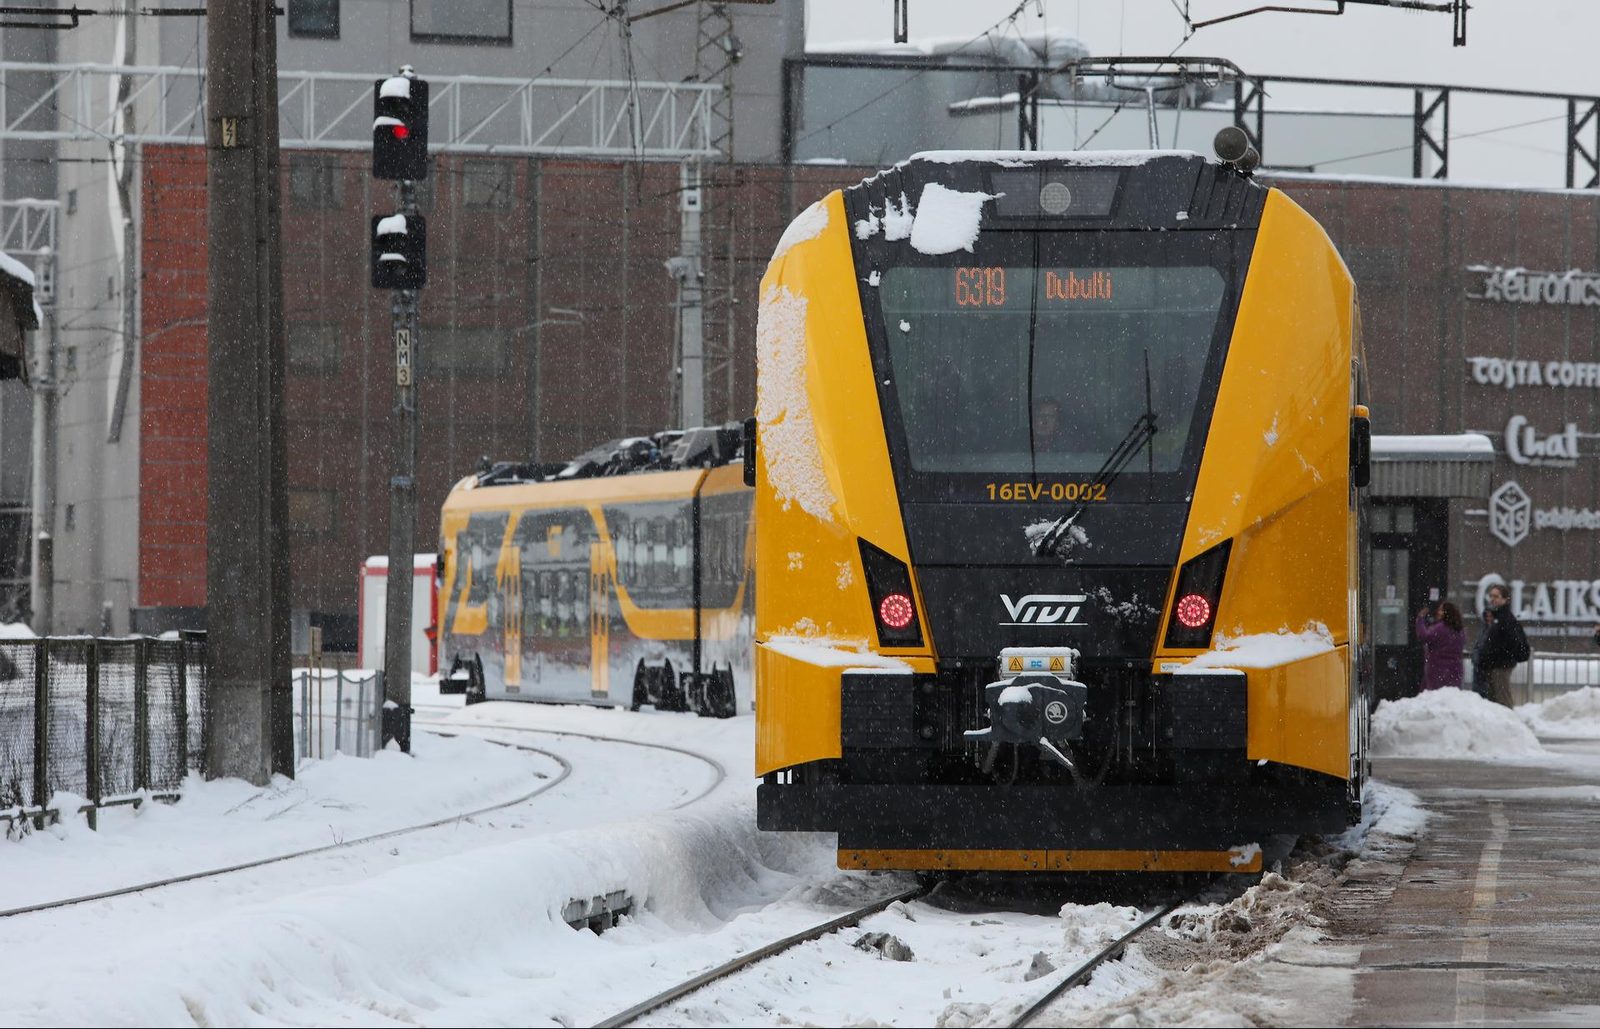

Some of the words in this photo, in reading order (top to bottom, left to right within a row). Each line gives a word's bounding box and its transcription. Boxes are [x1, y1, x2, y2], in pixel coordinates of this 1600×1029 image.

[955, 266, 1006, 306] 6319
[1046, 271, 1114, 300] Dubulti
[1472, 357, 1542, 388] COSTA
[1506, 415, 1579, 465] Chat
[986, 482, 1107, 501] 16EV-0002
